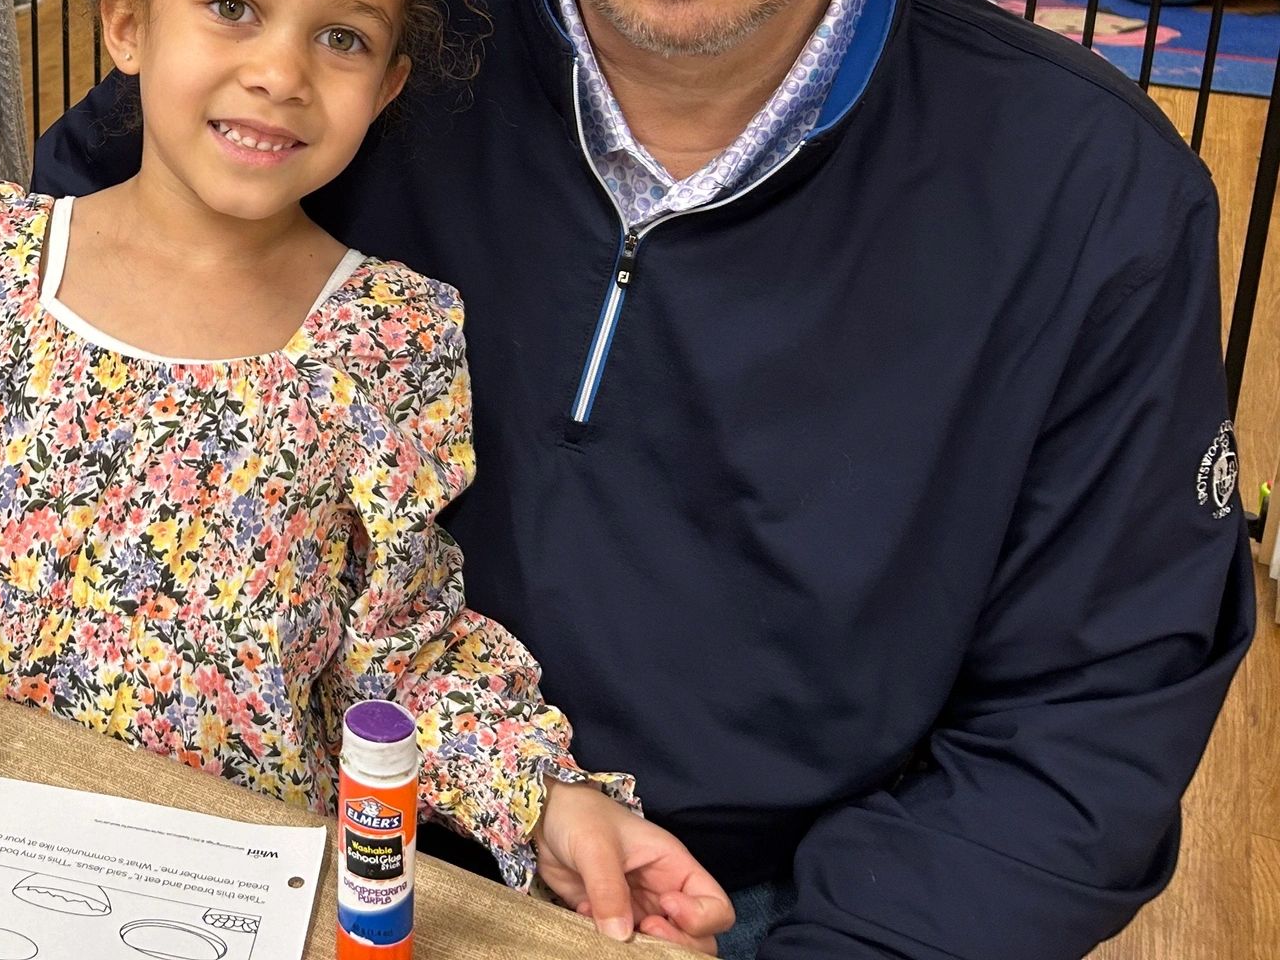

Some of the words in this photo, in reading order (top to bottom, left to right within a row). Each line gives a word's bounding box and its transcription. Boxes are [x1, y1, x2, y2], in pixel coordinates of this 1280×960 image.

[347, 808, 399, 828] ELMER'S
[4, 835, 26, 844] your
[38, 842, 55, 852] like
[352, 840, 393, 855] Washable
[21, 850, 36, 859] my
[38, 854, 46, 862] is
[56, 846, 116, 862] communion
[247, 848, 278, 859] Whirl
[347, 846, 379, 864] School
[380, 854, 401, 864] Glue
[74, 862, 104, 874] Jesus.
[118, 858, 152, 871] What's
[381, 861, 401, 871] Stick
[106, 868, 127, 878] said
[180, 870, 234, 886] remember
[144, 875, 160, 884] eat
[162, 879, 182, 888] and
[184, 883, 214, 896] bread
[238, 880, 270, 892] bread,
[216, 889, 236, 900] this
